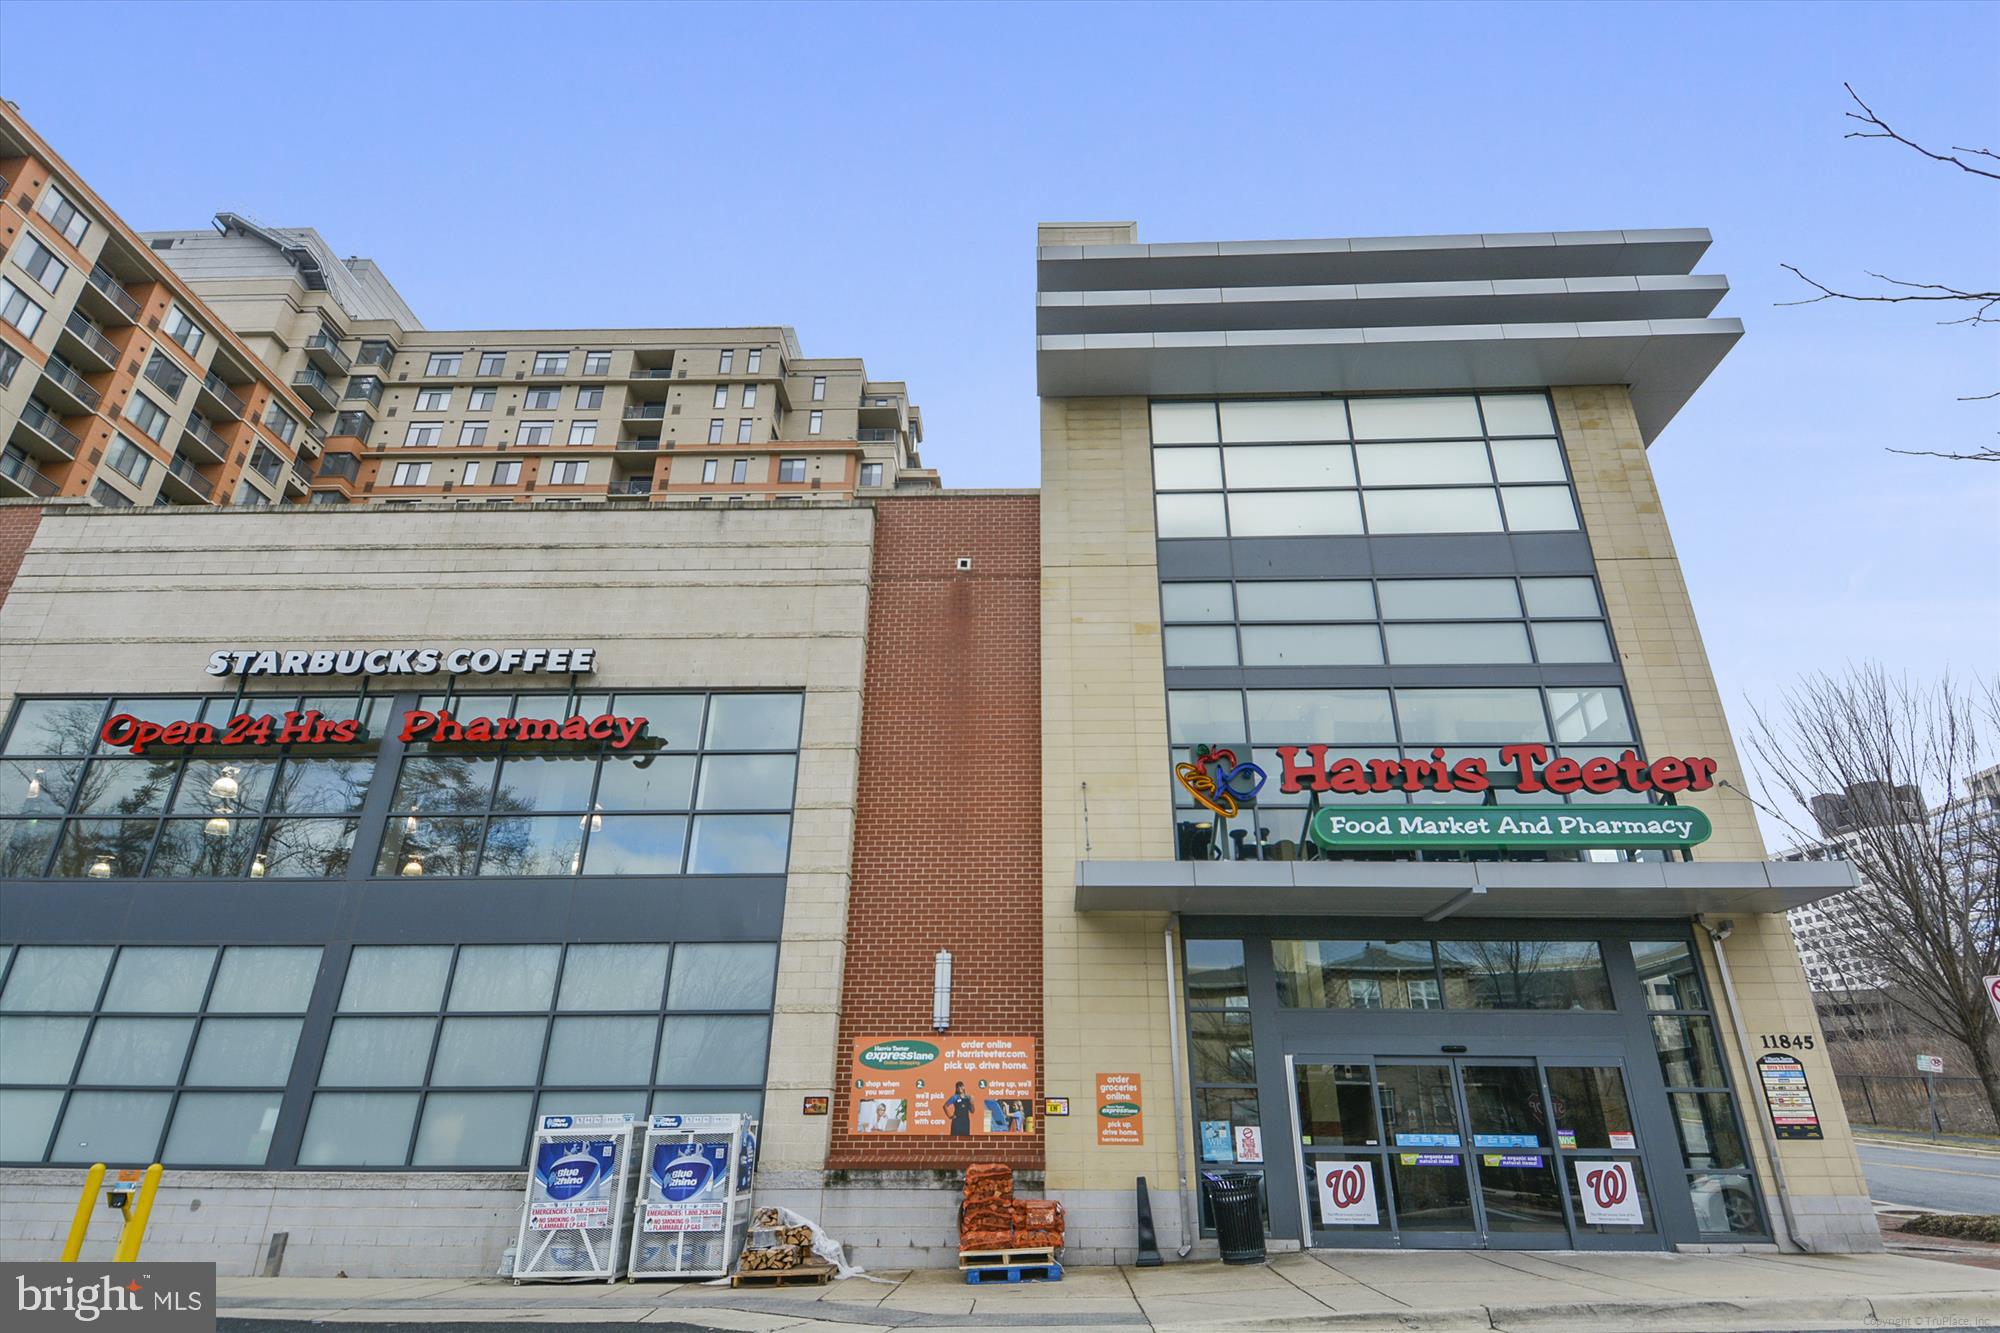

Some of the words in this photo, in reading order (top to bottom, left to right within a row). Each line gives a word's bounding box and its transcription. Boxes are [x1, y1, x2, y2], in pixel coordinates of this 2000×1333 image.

[204, 649, 440, 676] STARBUCKS
[446, 648, 595, 675] COFFEE
[101, 713, 214, 754] Open
[221, 713, 272, 745] 24
[275, 709, 360, 744] Hrs
[397, 709, 649, 749] Pharmacy
[1276, 744, 1489, 794] Harris
[1499, 743, 1717, 794] Teeter
[1330, 816, 1392, 834] Food
[1398, 816, 1490, 834] Market
[1497, 816, 1553, 834] And
[1559, 816, 1692, 839] Pharmacy
[961, 1040, 984, 1048] order
[986, 1040, 1012, 1048] online
[1760, 1034, 1814, 1050] 11845
[945, 1050, 955, 1058] at
[944, 1061, 962, 1071] pick
[979, 1061, 1000, 1069] drive
[1002, 1061, 1028, 1069] home.
[1107, 1075, 1129, 1083] order
[1100, 1083, 1137, 1093] groceries
[930, 1092, 944, 1100] pick
[914, 1109, 932, 1117] pack
[558, 1168, 579, 1177] Blue
[672, 1169, 693, 1178] Blue
[1326, 1164, 1365, 1208] W
[1586, 1164, 1627, 1208] W
